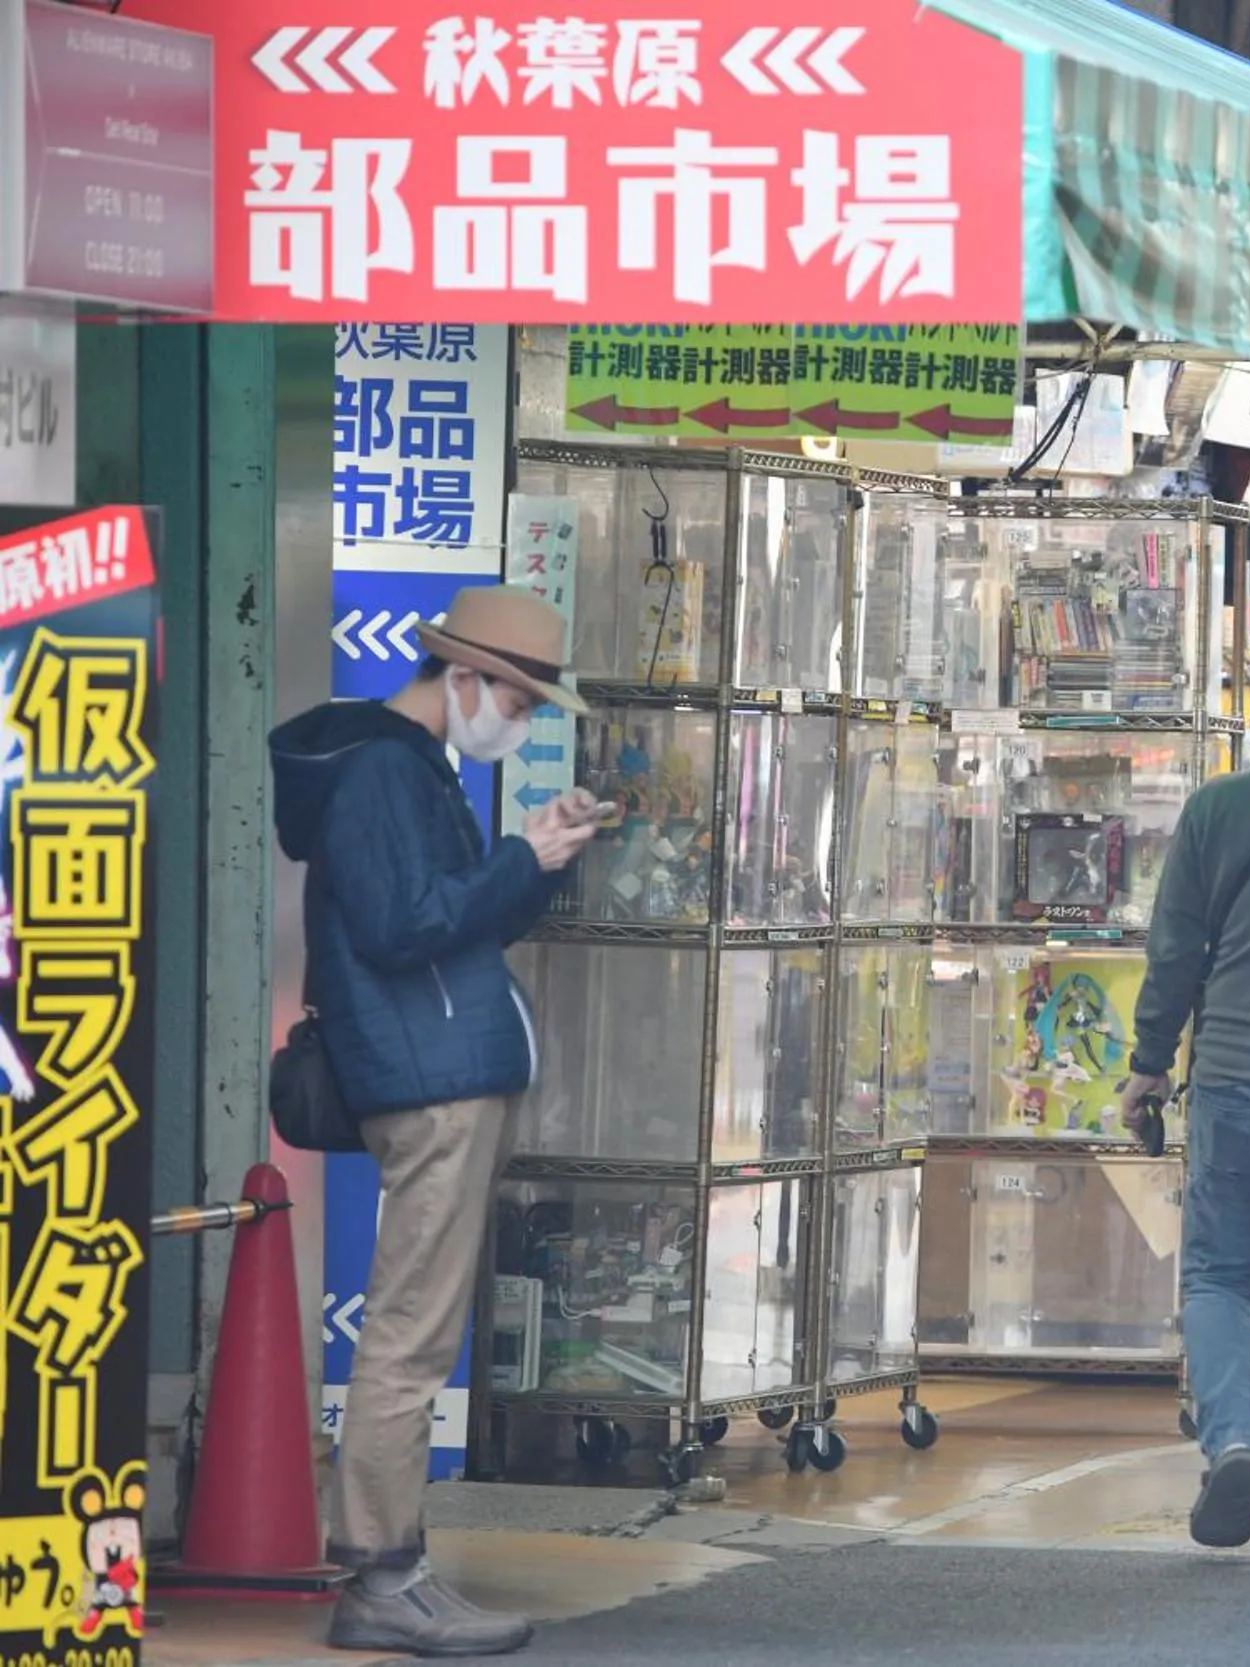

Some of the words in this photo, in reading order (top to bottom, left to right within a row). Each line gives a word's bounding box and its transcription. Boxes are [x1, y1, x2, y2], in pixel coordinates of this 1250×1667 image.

[423, 16, 702, 109] 秋葉原
[243, 128, 959, 304] 部品市場
[568, 340, 681, 382] 計測器
[682, 346, 791, 386] 計測器
[793, 344, 903, 386] 計測器
[904, 351, 1017, 396] 計測器
[332, 464, 475, 550] 市場
[5, 627, 157, 1488] 仮面ライダー
